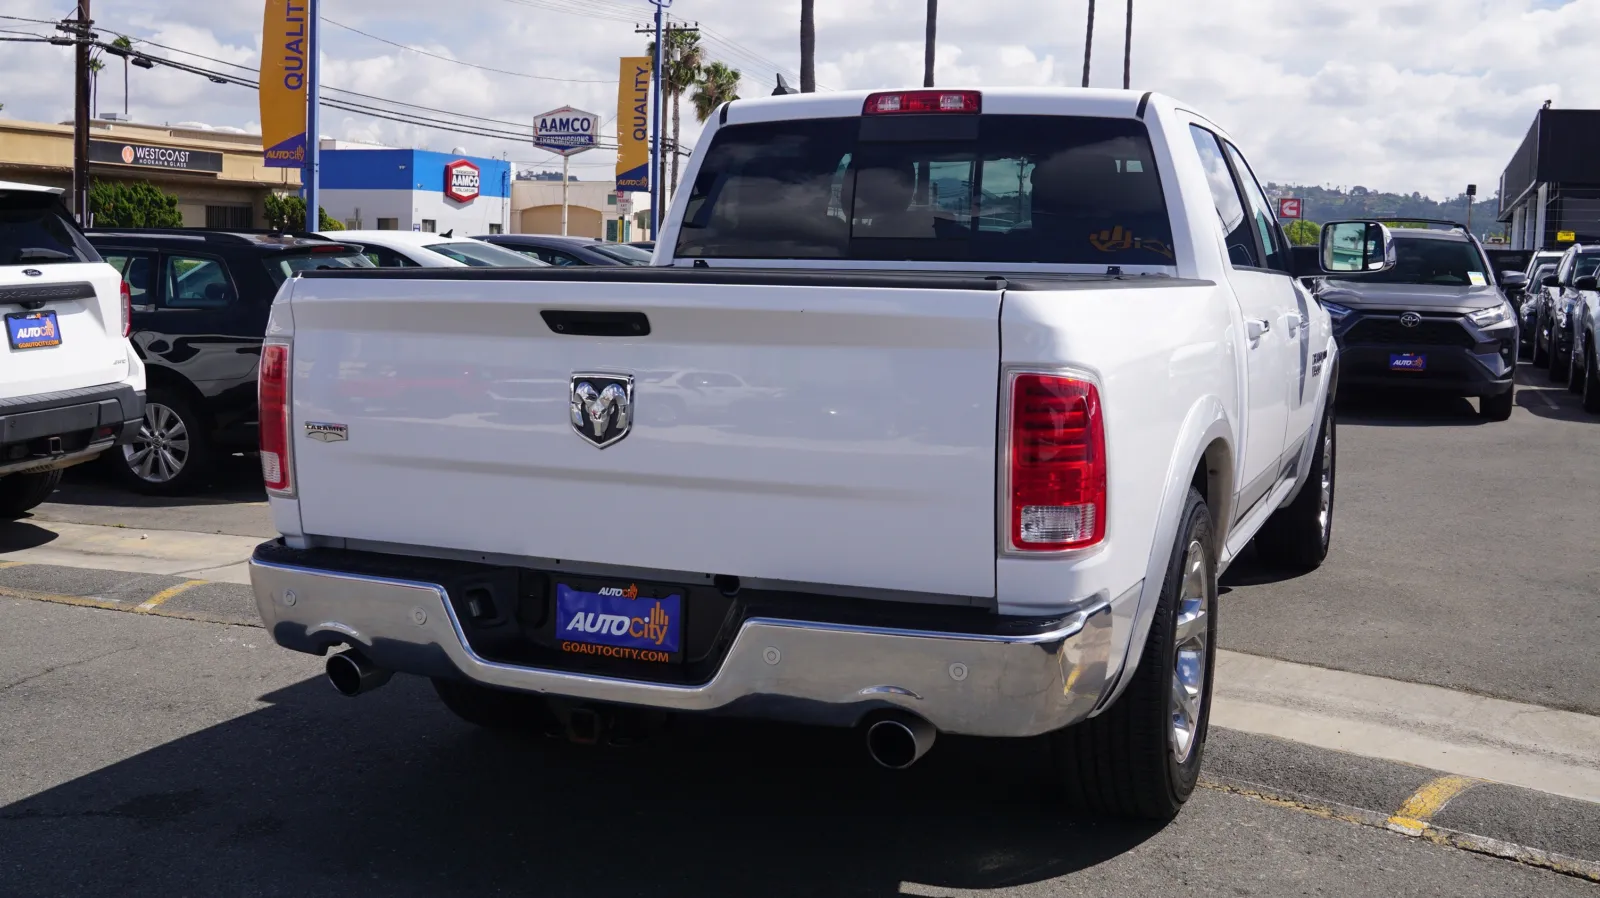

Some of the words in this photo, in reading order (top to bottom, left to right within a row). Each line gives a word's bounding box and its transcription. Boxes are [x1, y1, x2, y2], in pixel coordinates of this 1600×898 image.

[284, 0, 304, 91] QUALIT
[633, 62, 649, 141] QUALITY.
[539, 117, 591, 132] AAMCO
[136, 146, 190, 163] WESTCOAST
[452, 175, 479, 187] AAMCO
[0, 287, 80, 299] XPLORER
[17, 318, 55, 338] AUTOCity
[18, 340, 60, 349] GOAUTOCITY.COM
[598, 583, 638, 600] AUTOCity
[566, 602, 669, 645] AUTOCity
[562, 641, 669, 663] GOAUTOCITY.COM
